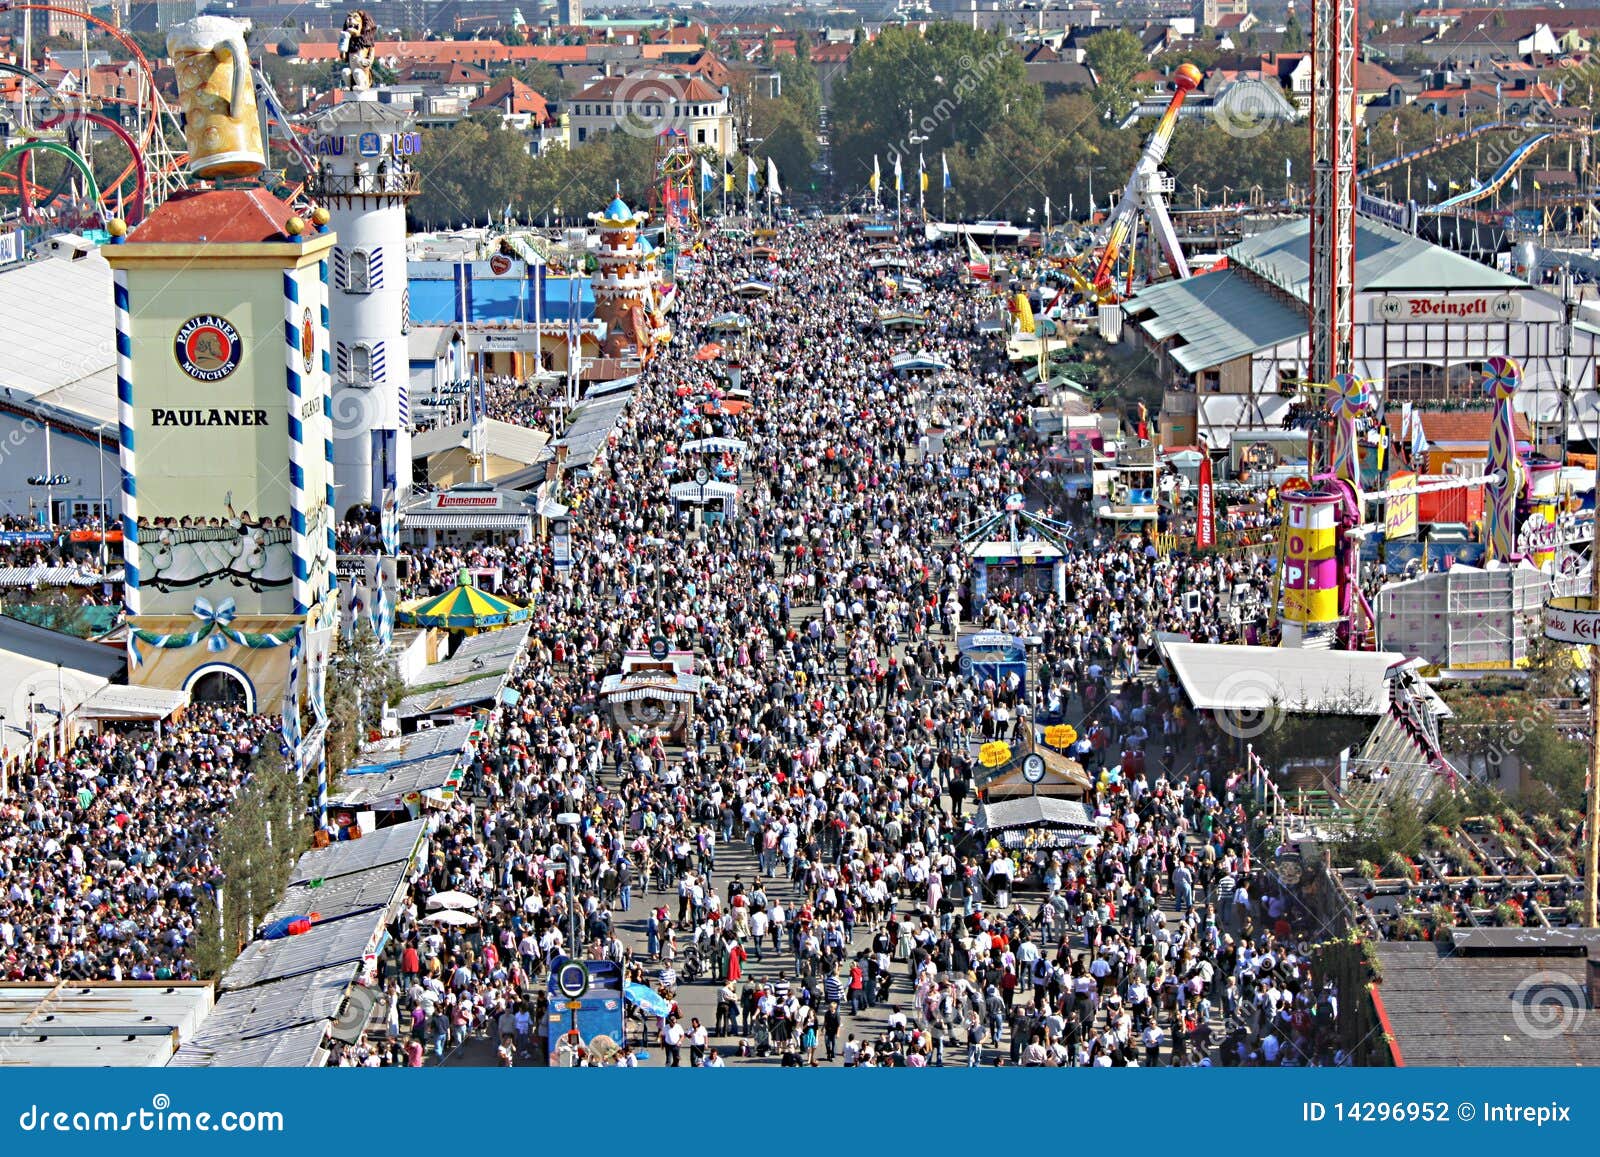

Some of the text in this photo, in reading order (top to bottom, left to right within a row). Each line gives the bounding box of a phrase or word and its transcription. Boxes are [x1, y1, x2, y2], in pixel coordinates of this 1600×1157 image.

[1408, 299, 1487, 316] Weinzelt
[177, 315, 239, 344] PAULANER
[151, 409, 268, 427] PAULANER
[437, 494, 498, 508] Zimmermann
[1201, 483, 1211, 544] HIGH SPEED
